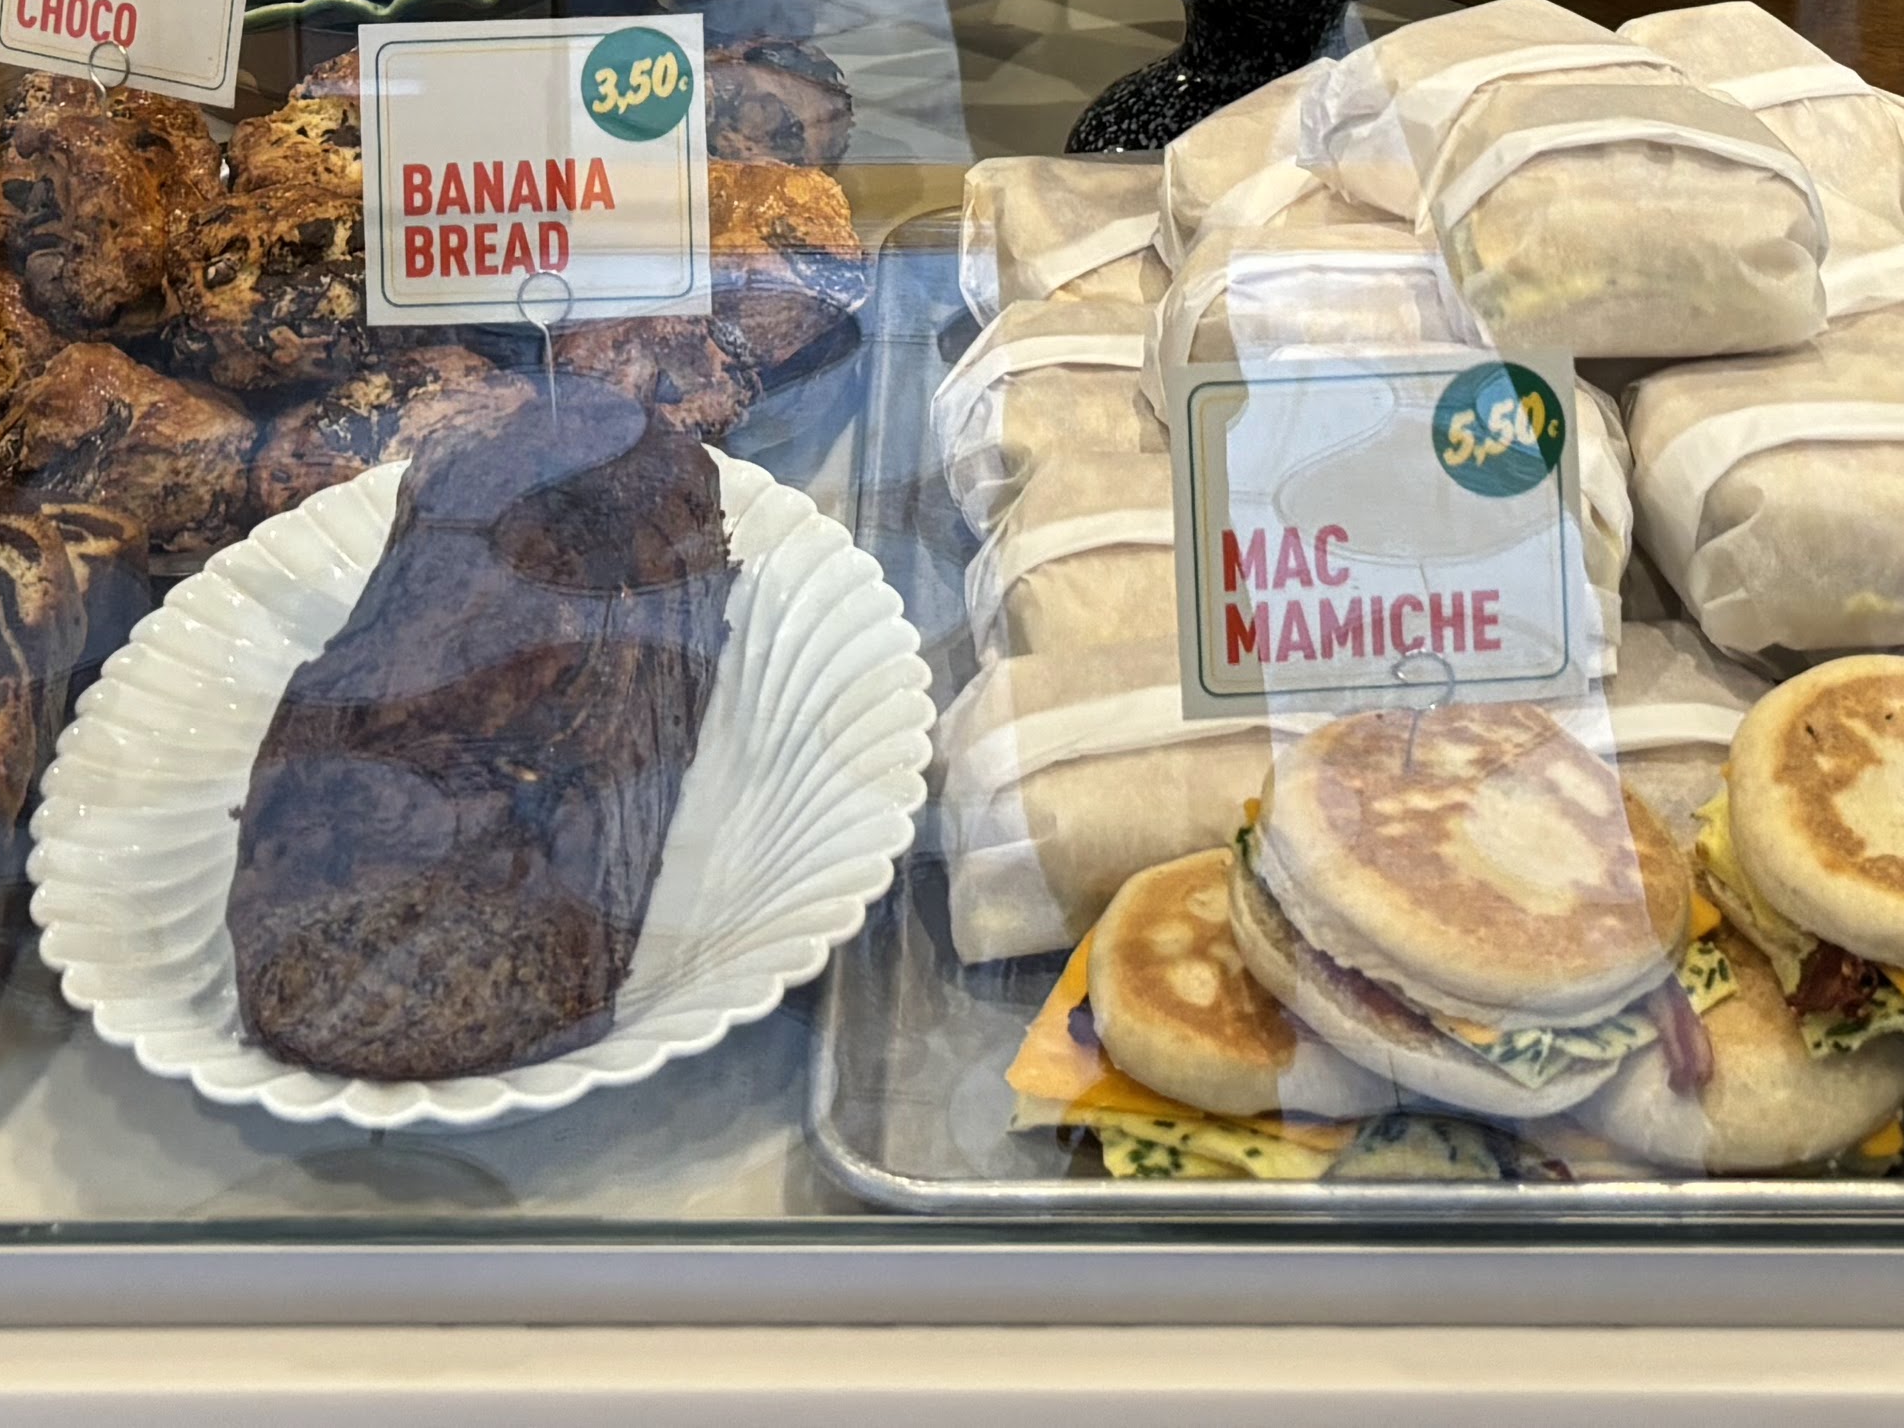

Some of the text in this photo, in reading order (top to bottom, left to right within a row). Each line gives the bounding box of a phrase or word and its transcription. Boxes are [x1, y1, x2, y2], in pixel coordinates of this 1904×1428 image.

[402, 157, 616, 217] BANANA
[404, 221, 570, 279] BREAD
[1221, 524, 1350, 593] MAC
[1224, 589, 1502, 665] MAMICHE
